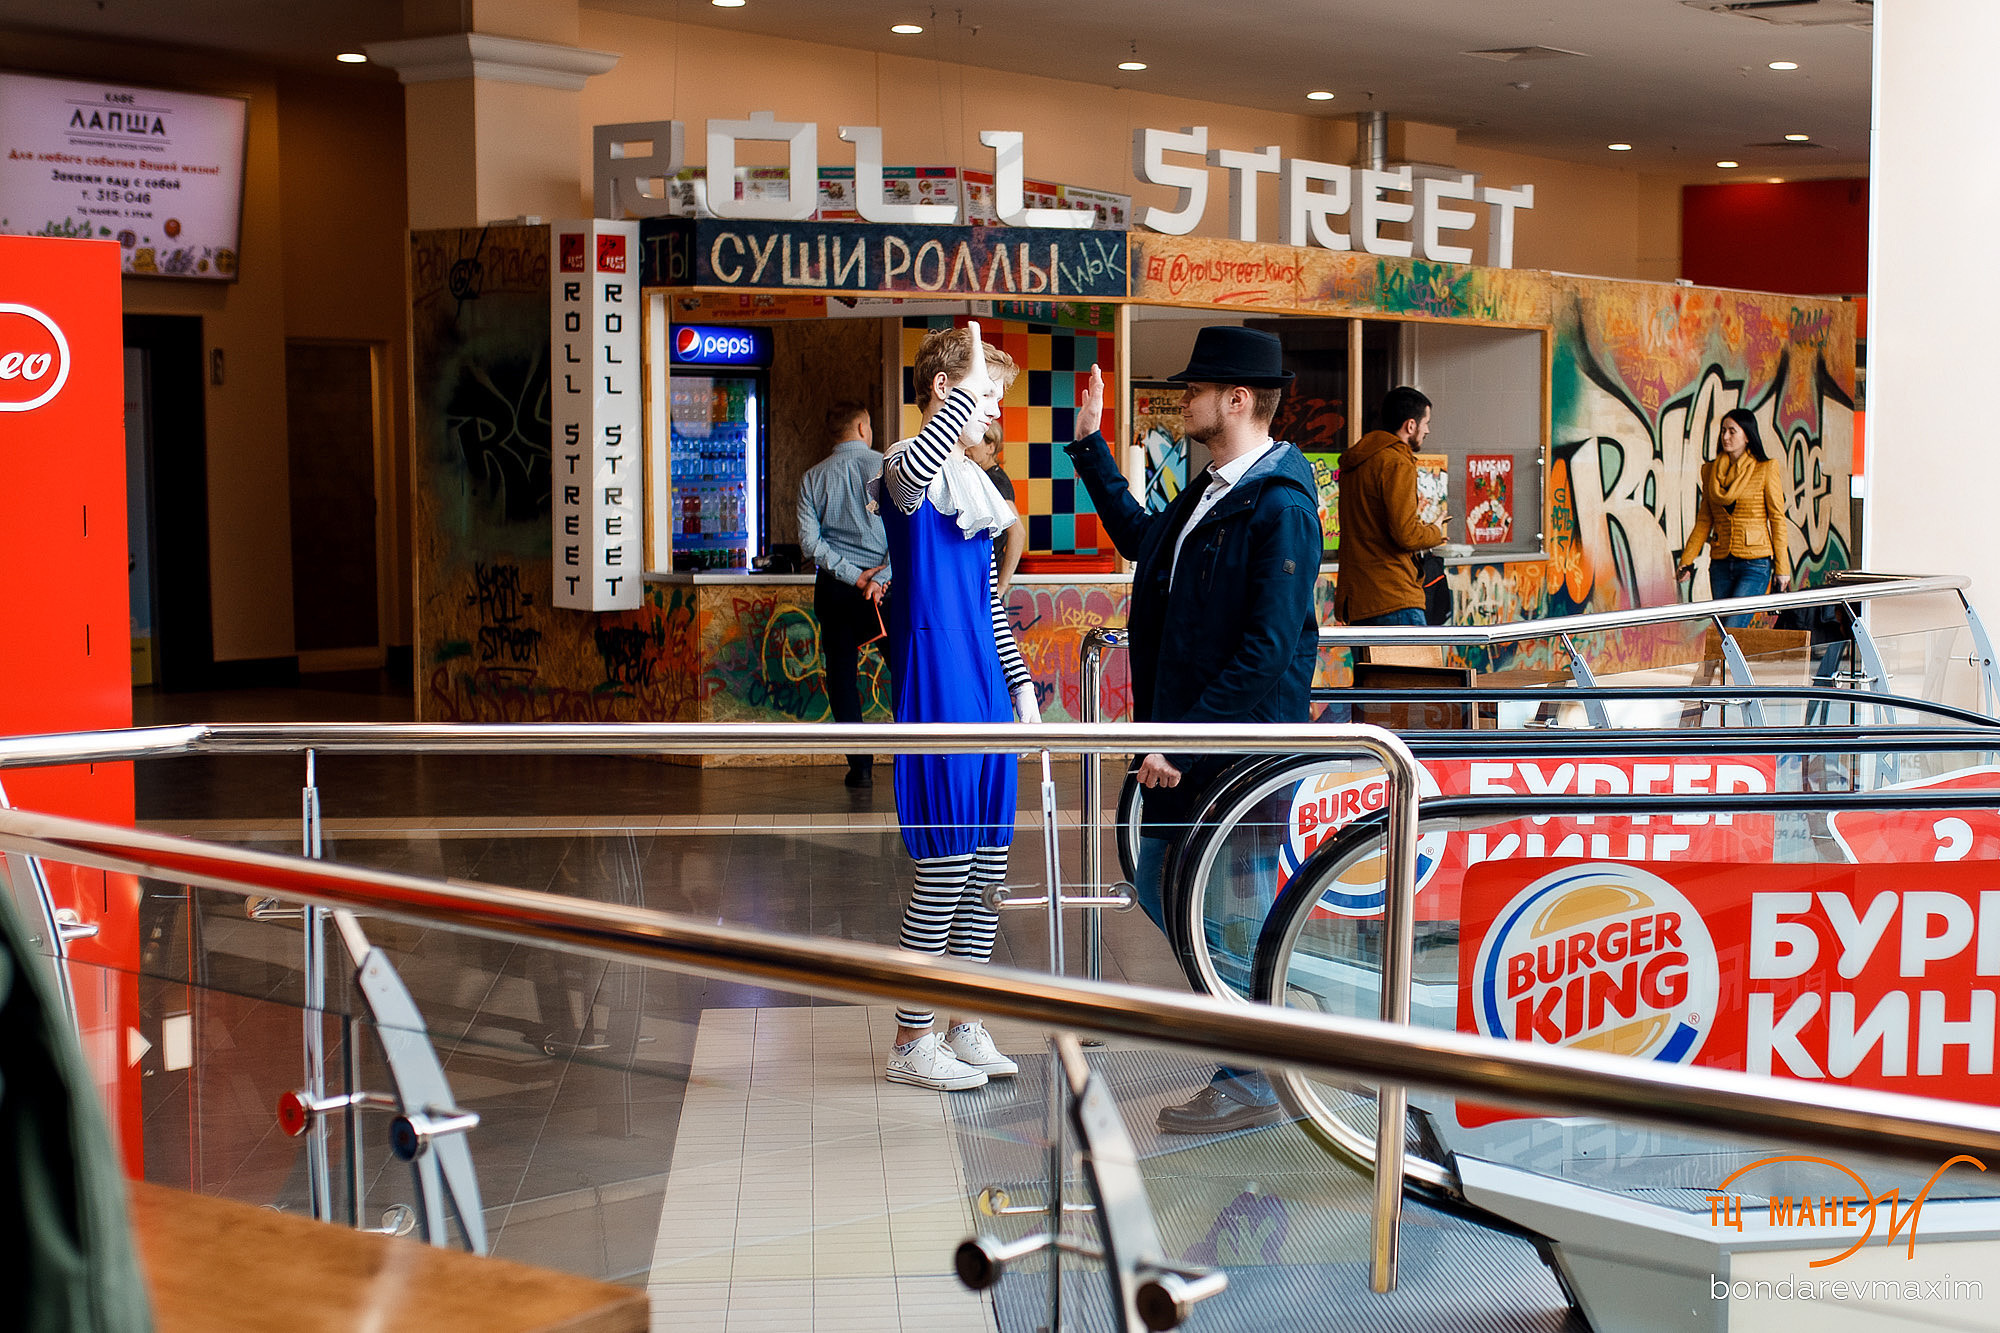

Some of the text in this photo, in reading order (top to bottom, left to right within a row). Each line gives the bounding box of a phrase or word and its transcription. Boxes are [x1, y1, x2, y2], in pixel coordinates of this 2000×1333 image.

[70, 108, 165, 136] ЛАПША
[144, 177, 181, 190] собой
[593, 111, 1534, 269] ROLL STREET
[710, 232, 866, 287] СУШИ
[884, 235, 1059, 294] РОЛЛЫ
[604, 283, 622, 395] ROLL
[704, 335, 754, 358] pepsi
[564, 423, 581, 596] STREET
[604, 424, 623, 597] STREET
[1298, 780, 1390, 836] BURG
[1507, 911, 1683, 1000] BURGER
[1515, 951, 1689, 1045] KING
